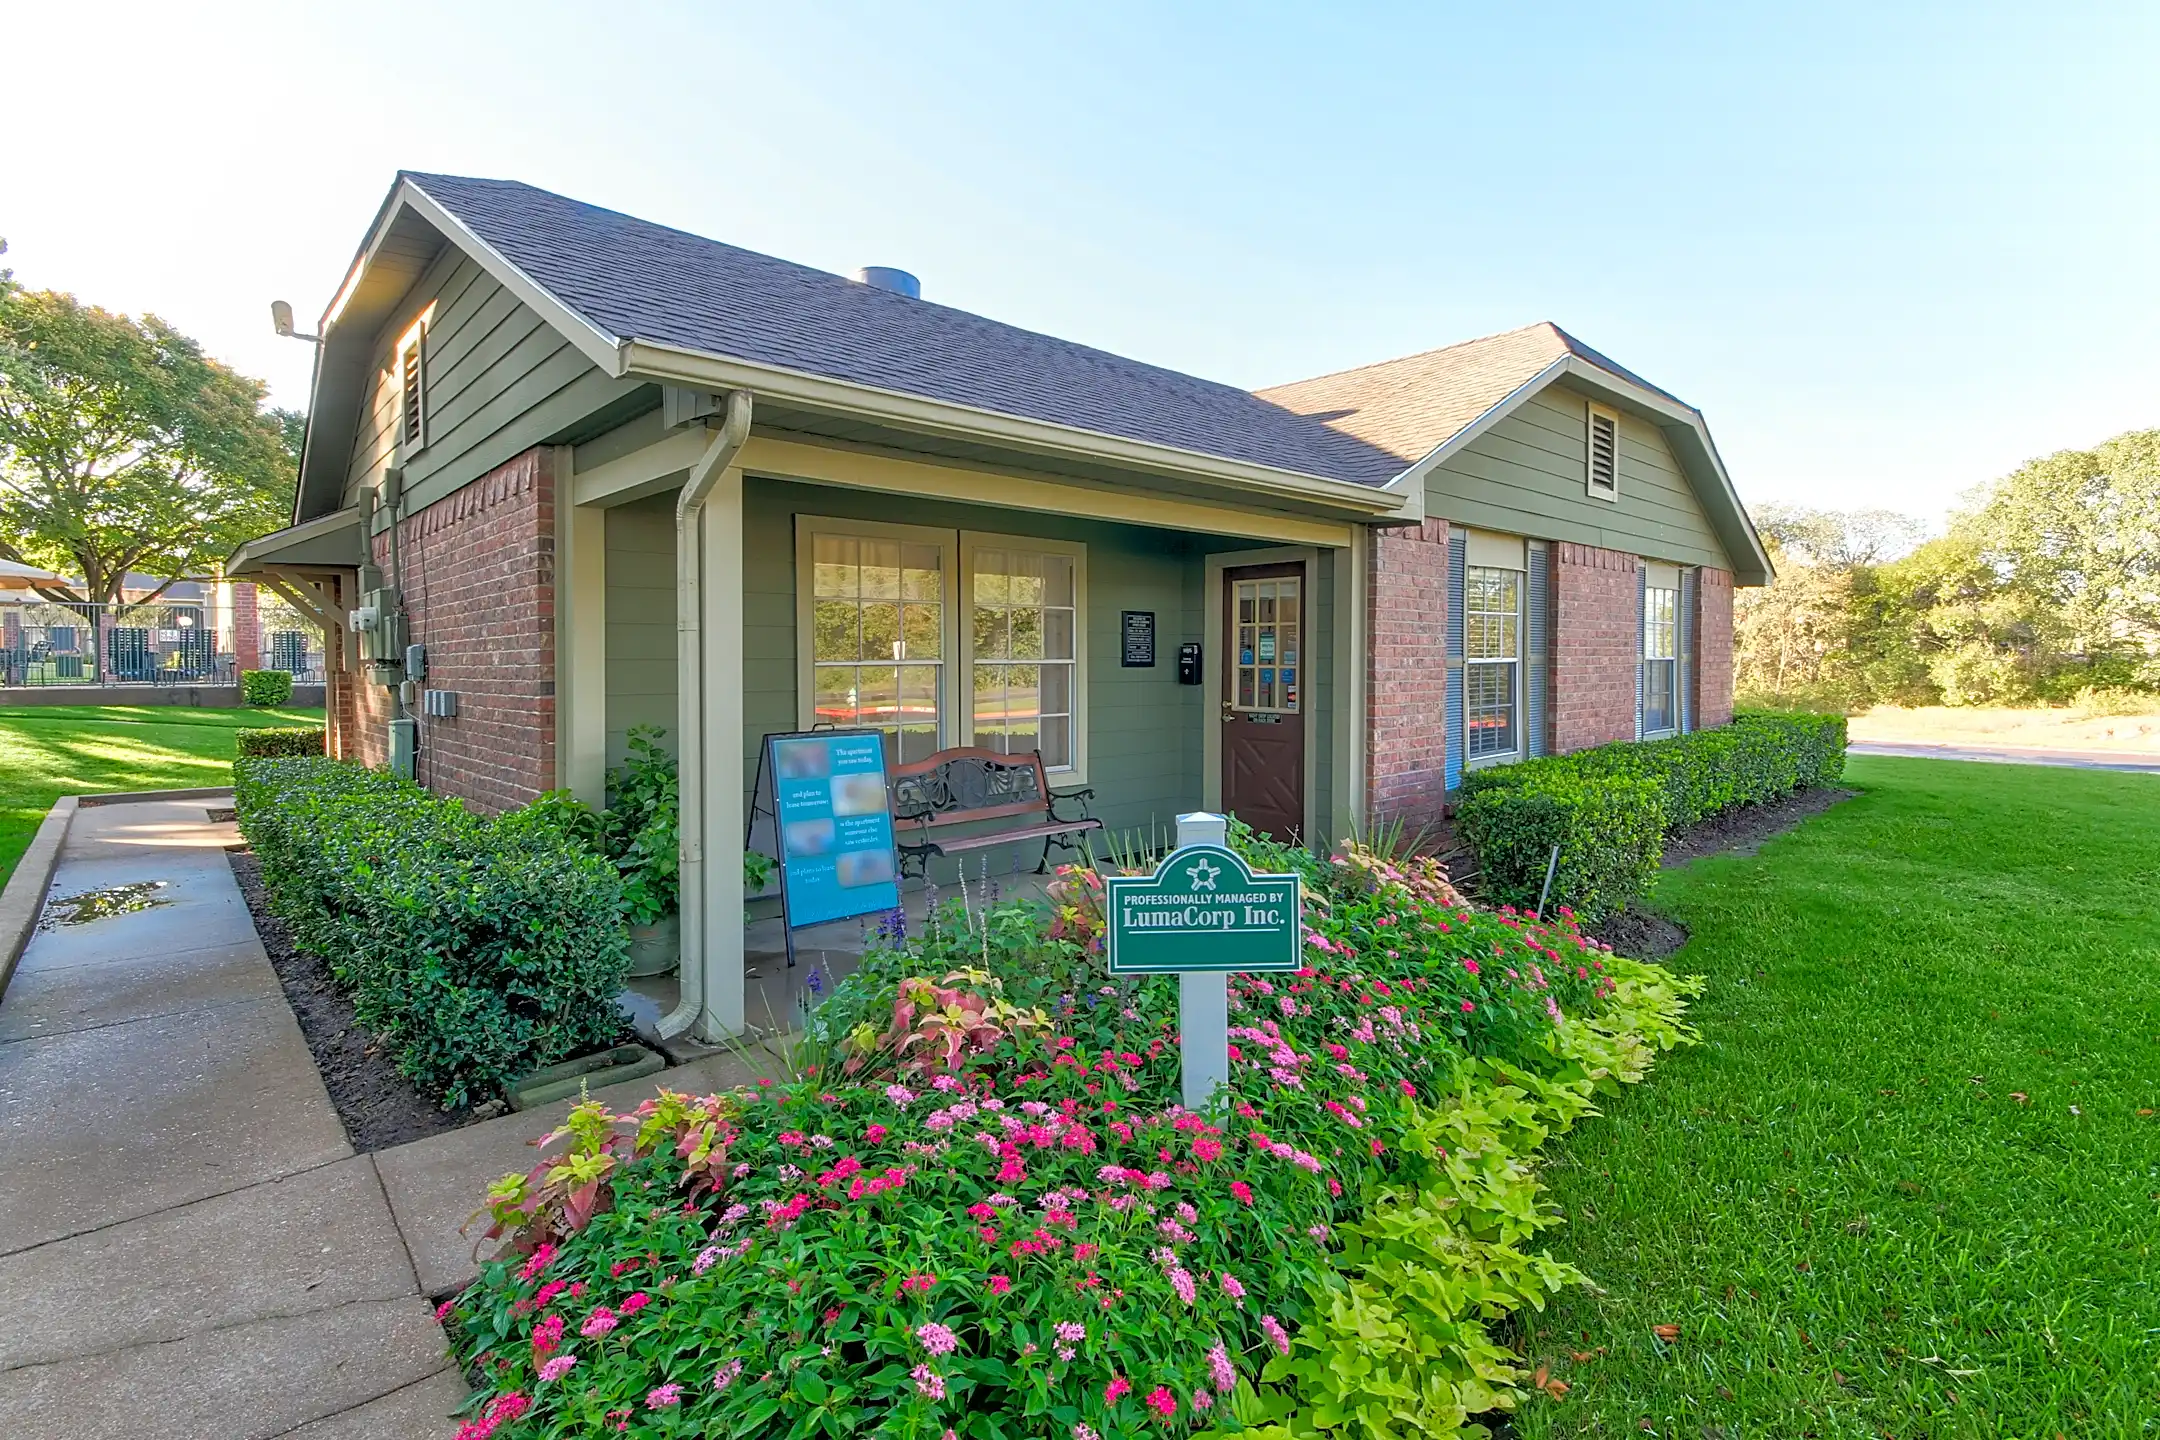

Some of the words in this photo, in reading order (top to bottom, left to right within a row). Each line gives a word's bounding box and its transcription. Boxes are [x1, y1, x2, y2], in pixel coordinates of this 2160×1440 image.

[1124, 893, 1213, 905] PROFESSIONALLY
[1215, 892, 1267, 904] MANAGED
[1269, 892, 1284, 903] BY
[1123, 906, 1236, 930] LumaCorp
[1243, 905, 1286, 925] Inc.
